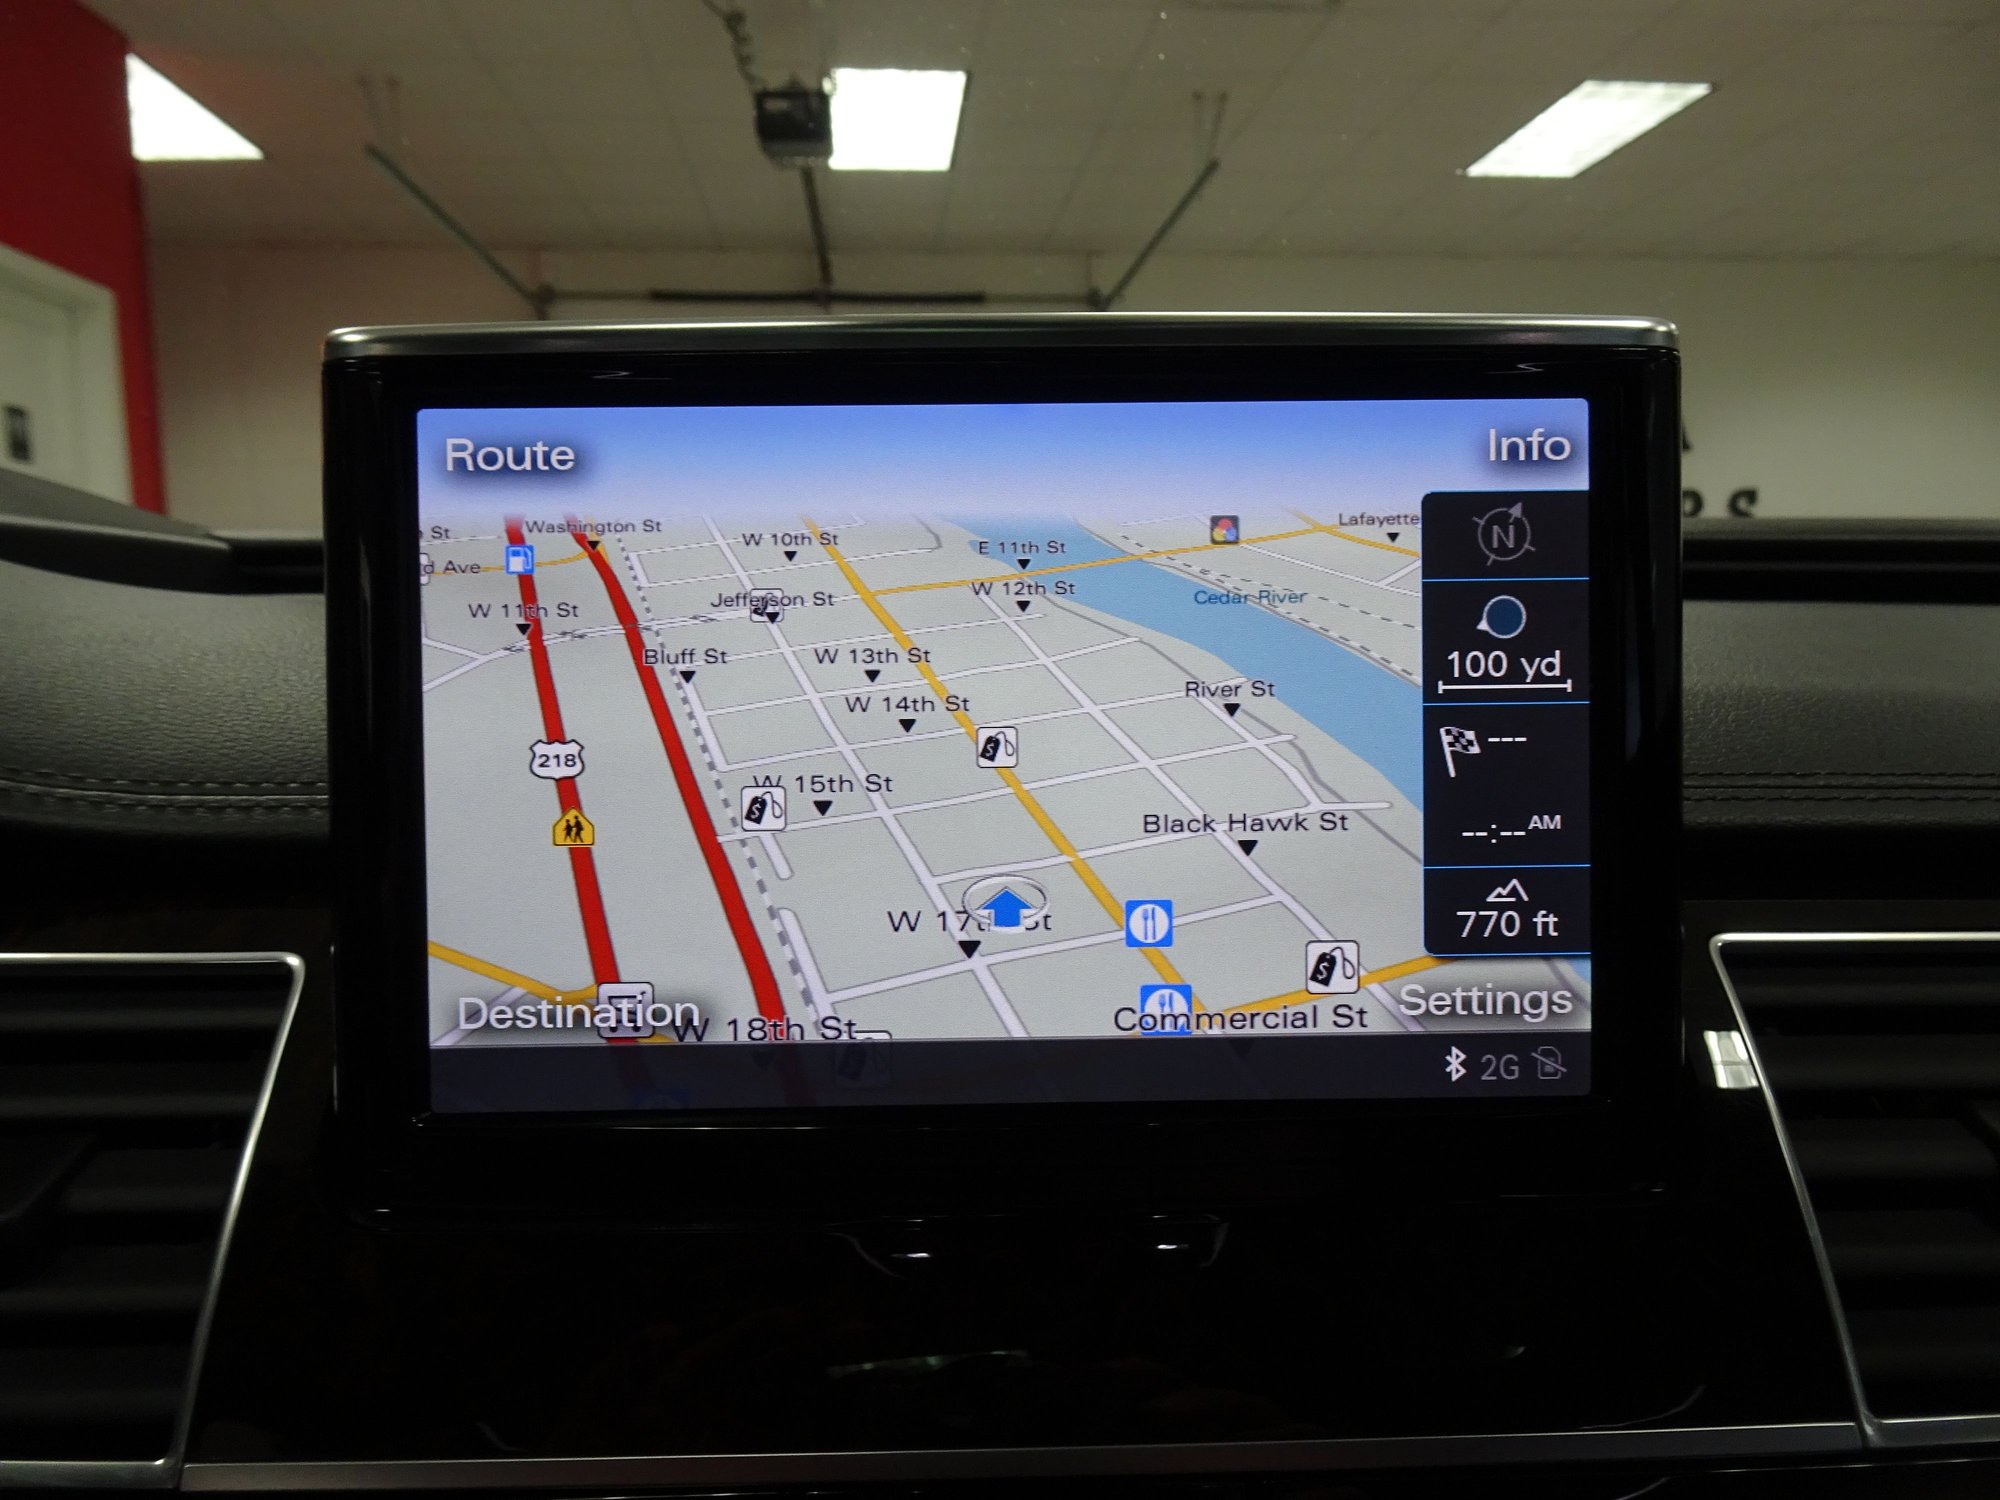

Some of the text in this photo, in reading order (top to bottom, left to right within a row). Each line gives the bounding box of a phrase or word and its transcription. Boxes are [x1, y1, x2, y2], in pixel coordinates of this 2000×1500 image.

[1488, 428, 1571, 461] Info
[446, 438, 575, 471] Route
[525, 519, 662, 537] Washington St
[1339, 512, 1420, 528] Lafayette
[431, 525, 450, 539] St
[742, 532, 839, 546] W 10th St
[978, 541, 1066, 554] E 11th St
[443, 560, 481, 574] Ave
[972, 581, 1075, 596] W 12th St
[711, 591, 835, 608] Jefferson St
[1194, 590, 1308, 605] Cedar River
[468, 602, 579, 618] W 11th St
[643, 649, 728, 666] Bluff St
[814, 648, 931, 664] W 13th St
[1447, 650, 1561, 682] 100 yd
[1185, 681, 1275, 698] River St
[845, 695, 970, 712] W 14th St
[538, 753, 577, 768] 218
[795, 775, 854, 793] 15th
[865, 774, 893, 792] St
[1143, 813, 1348, 834] Black Hawk St
[887, 911, 921, 932] W
[1456, 910, 1558, 938] 770 ft
[1399, 983, 1573, 1023] Settings
[457, 996, 700, 1030] Destination
[1113, 1004, 1368, 1031] Commercial St
[673, 1016, 856, 1042] W 18th St
[1481, 1054, 1519, 1081] 2G
